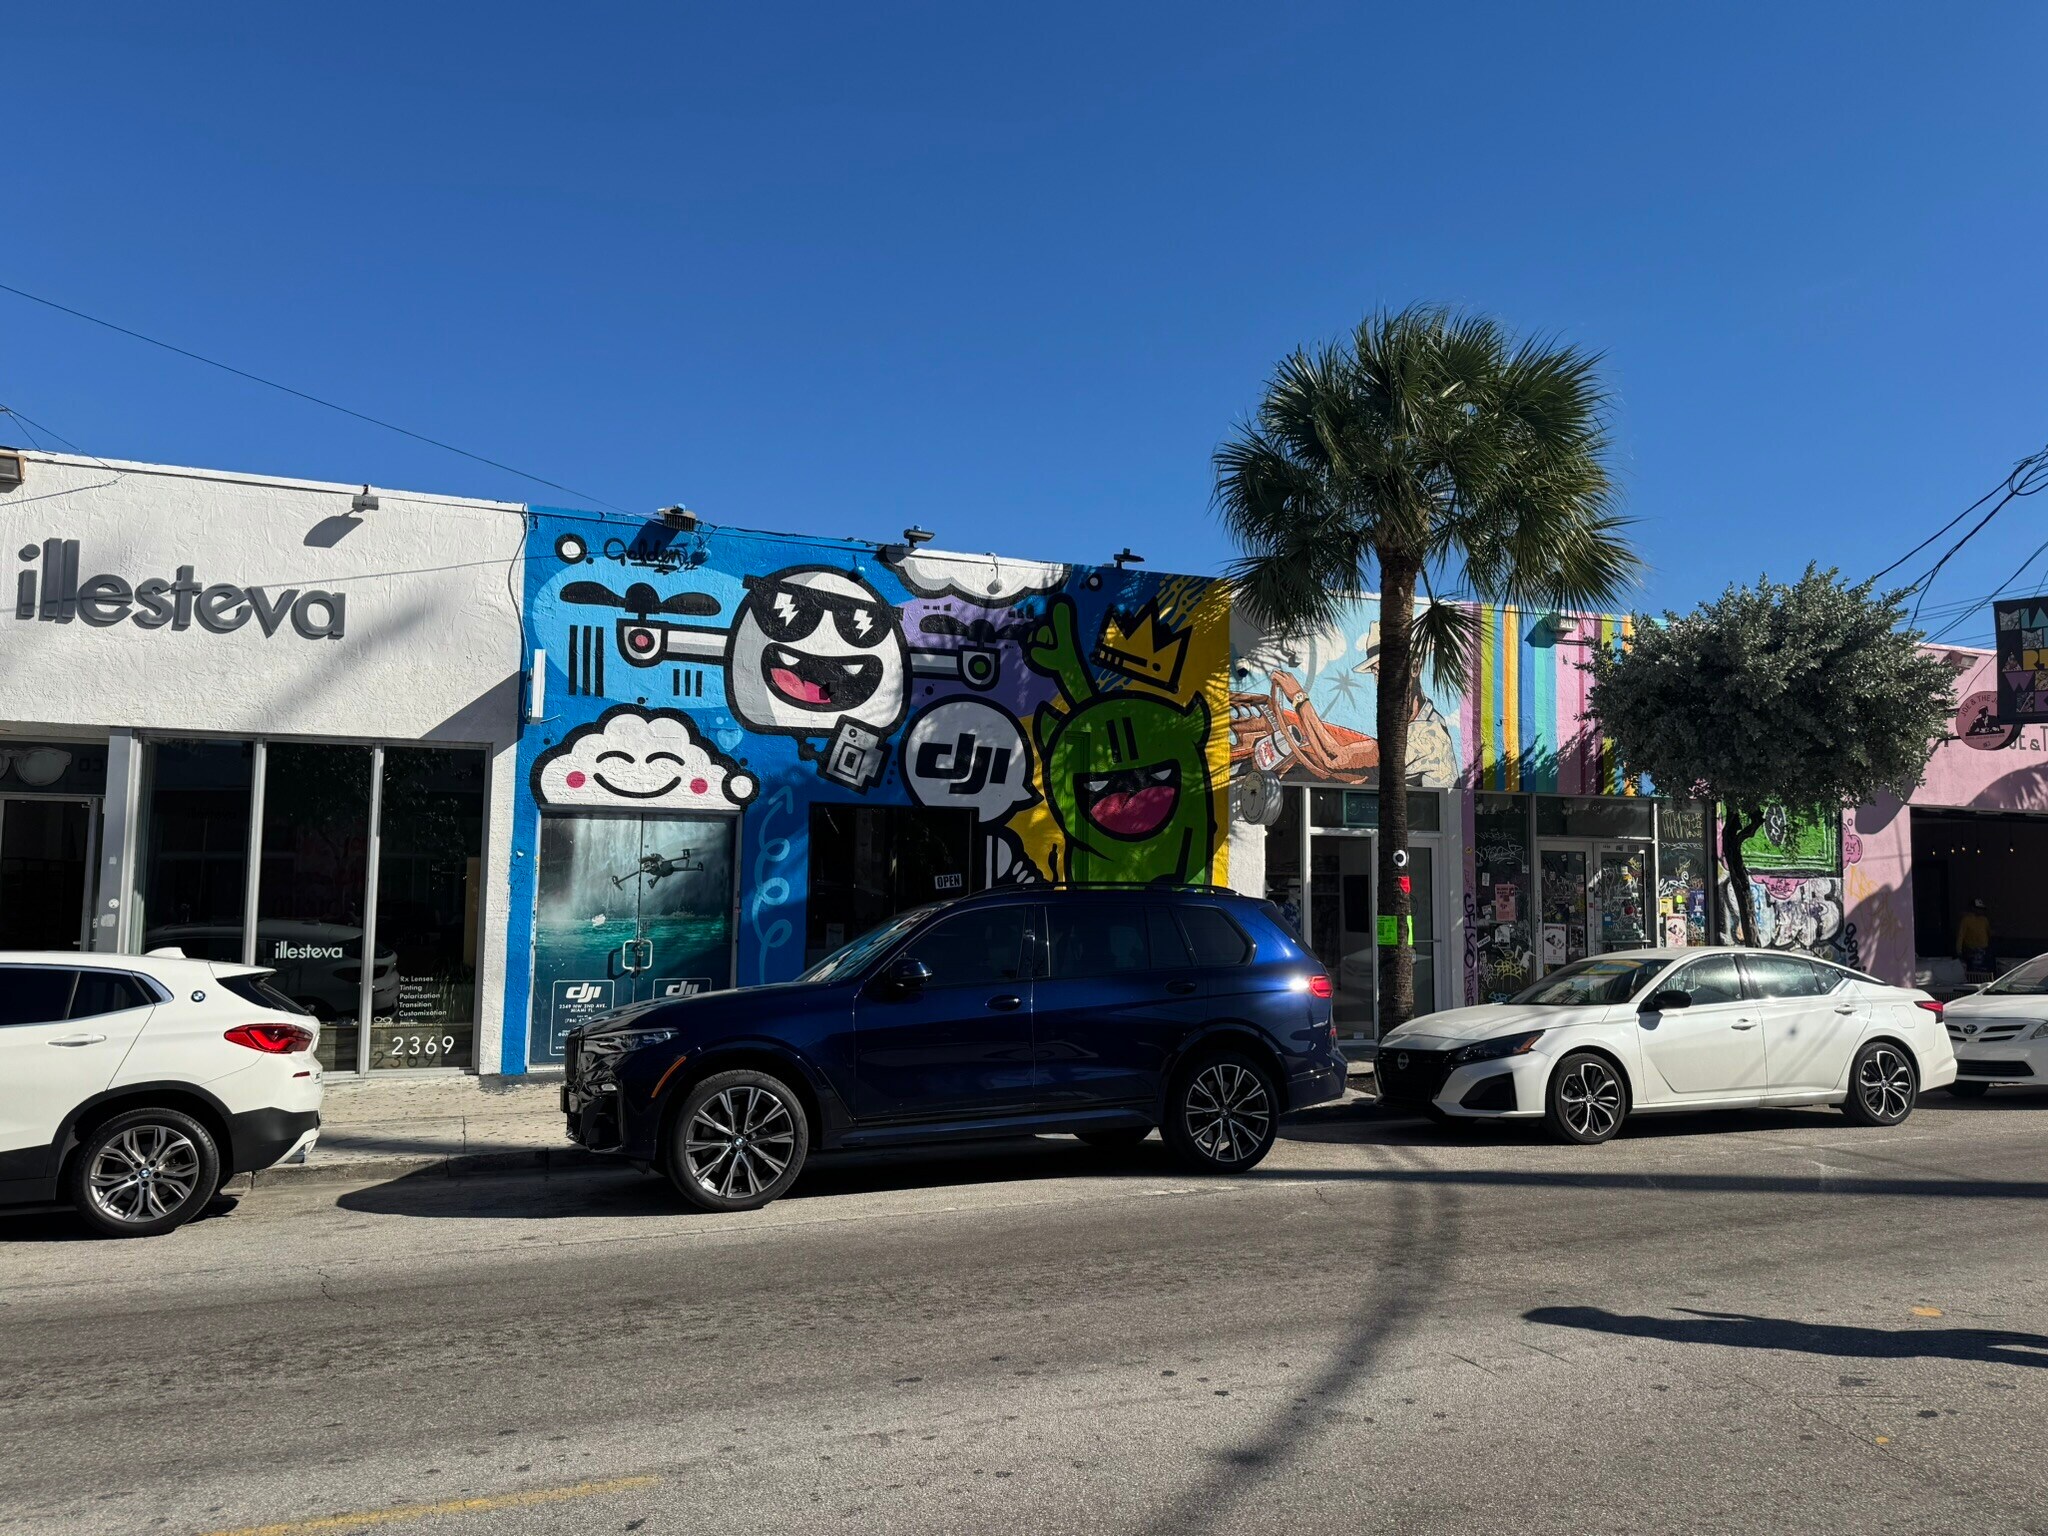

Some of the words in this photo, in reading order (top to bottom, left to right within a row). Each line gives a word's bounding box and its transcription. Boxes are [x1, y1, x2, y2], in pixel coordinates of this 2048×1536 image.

[16, 537, 346, 640] illesteva
[1977, 694, 1991, 703] THE
[936, 875, 960, 888] OPEN
[275, 941, 343, 959] illesteva
[400, 984, 423, 992] Tinting
[399, 992, 441, 1000] Polarization
[398, 1009, 447, 1017] Customization
[391, 1035, 455, 1055] 2369
